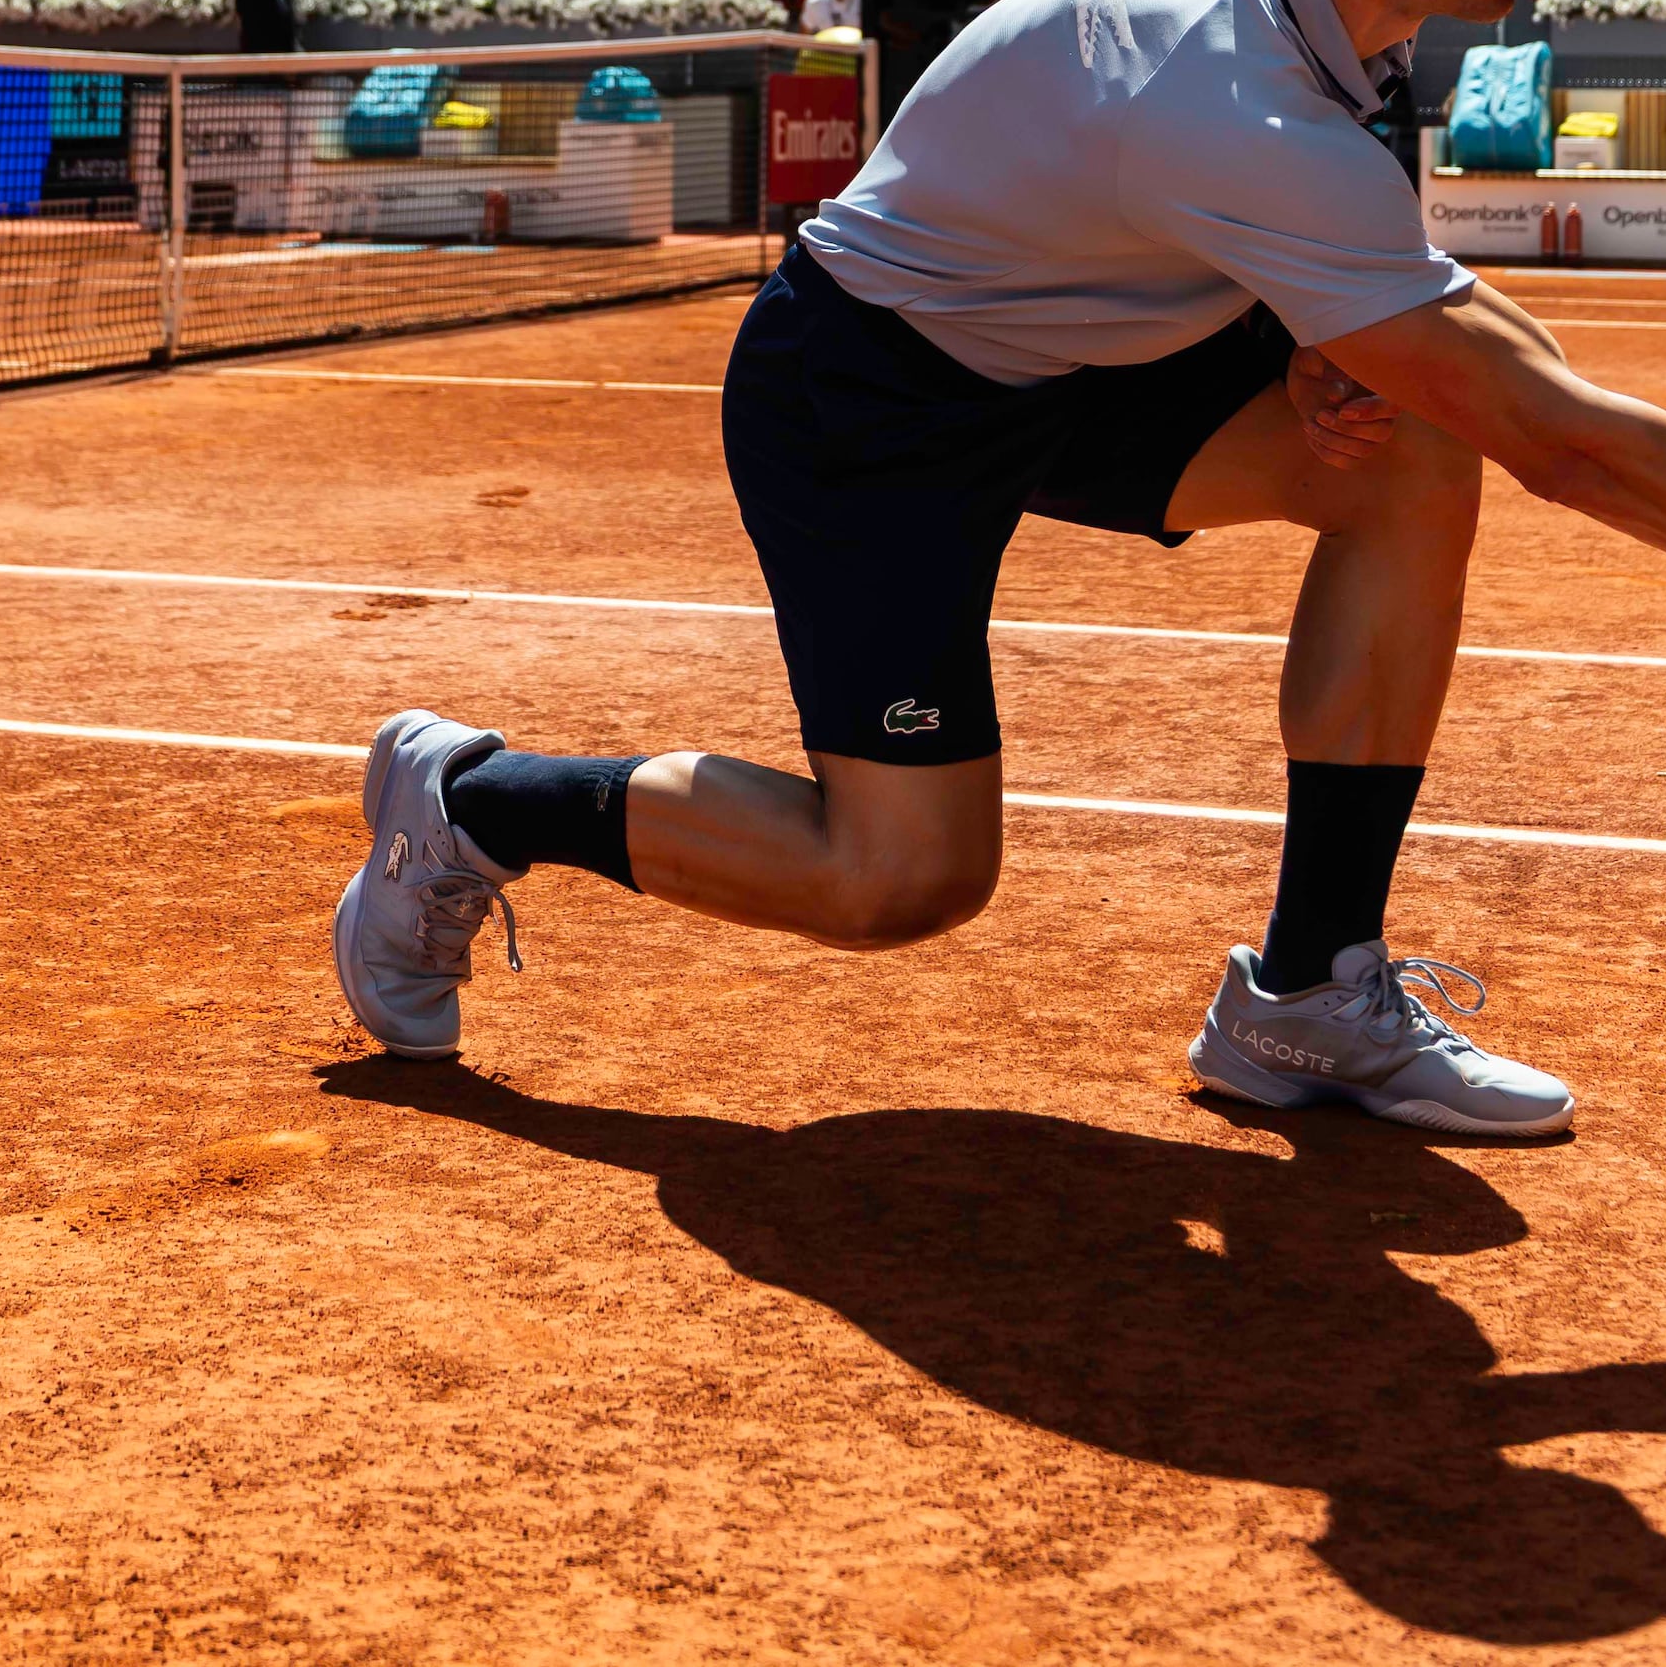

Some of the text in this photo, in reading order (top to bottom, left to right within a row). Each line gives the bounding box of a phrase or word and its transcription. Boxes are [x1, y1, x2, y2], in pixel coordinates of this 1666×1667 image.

[773, 108, 856, 162] Emirates
[1431, 202, 1529, 224] Openbank
[1232, 1020, 1336, 1073] LACOSTE
